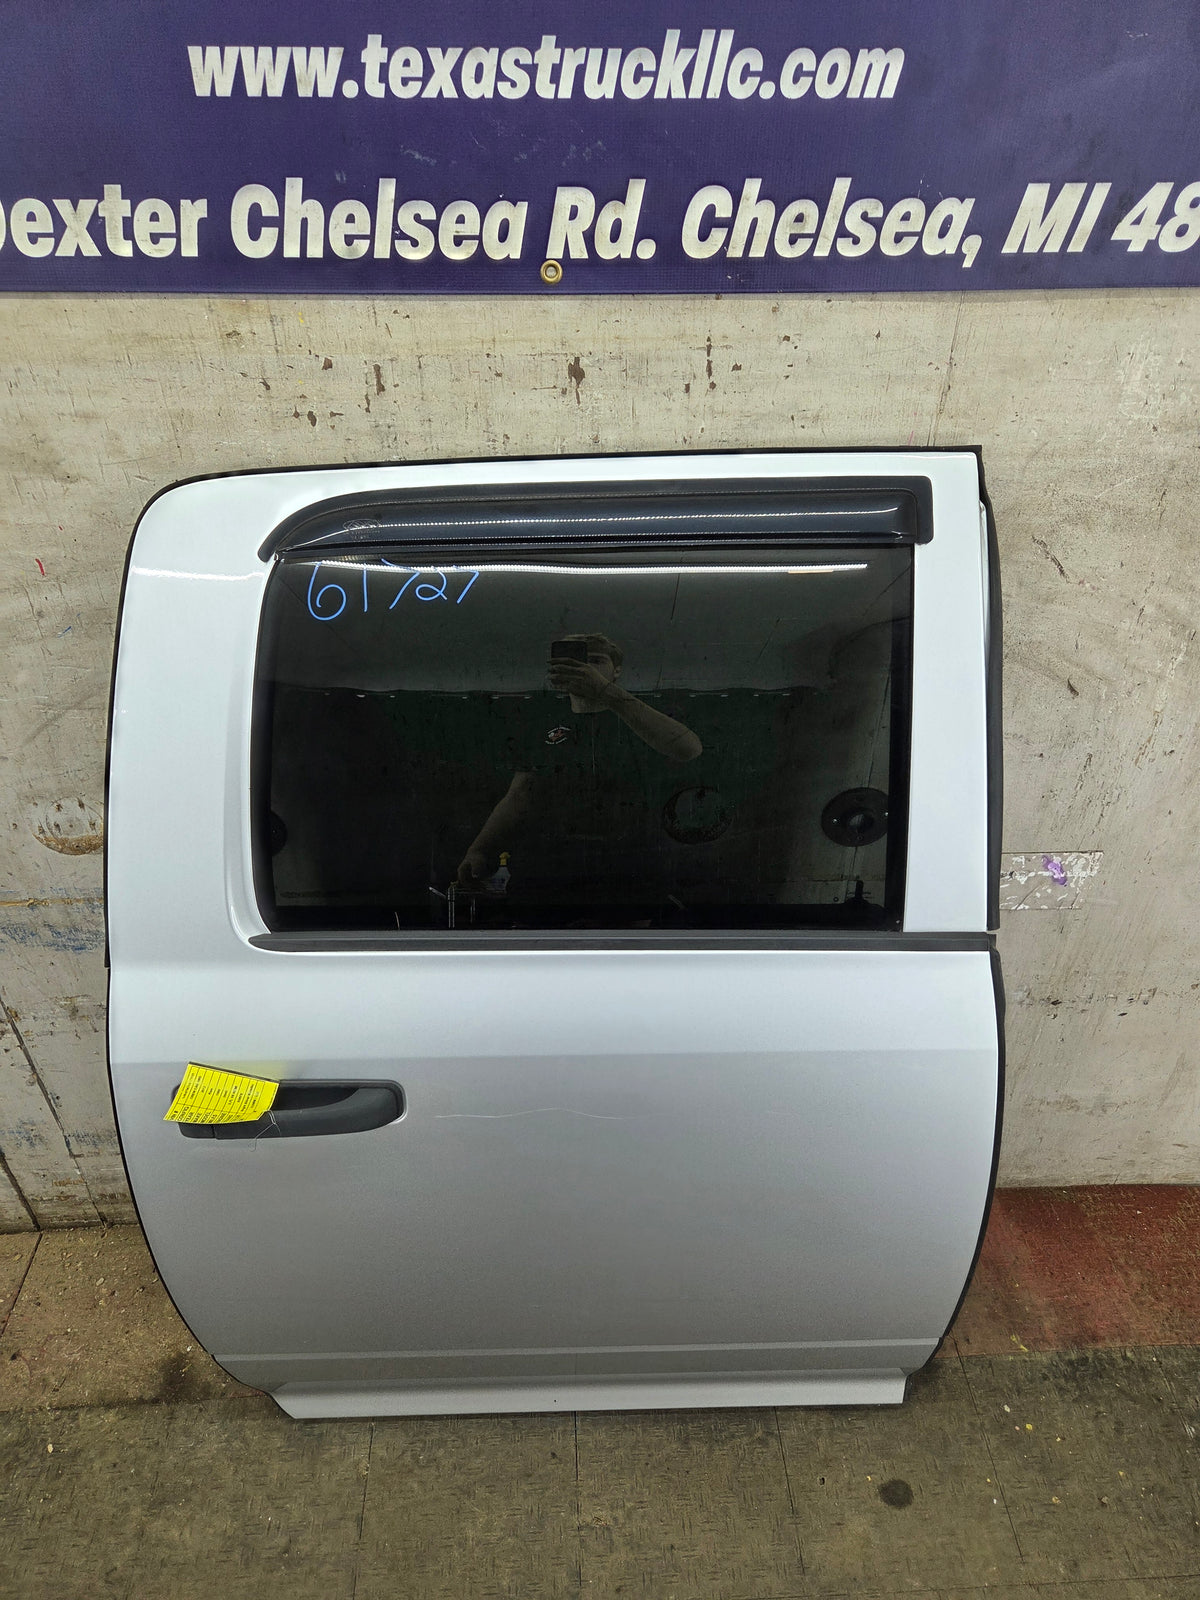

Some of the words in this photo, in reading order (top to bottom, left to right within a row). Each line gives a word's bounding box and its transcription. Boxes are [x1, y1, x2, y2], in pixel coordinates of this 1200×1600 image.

[188, 29, 905, 99] www.texastruckllc.com
[0, 184, 207, 258] exter
[231, 178, 528, 260] Chelsea
[546, 179, 657, 260] Rd.
[682, 178, 982, 268] Chelsea,
[1001, 182, 1112, 254] MI
